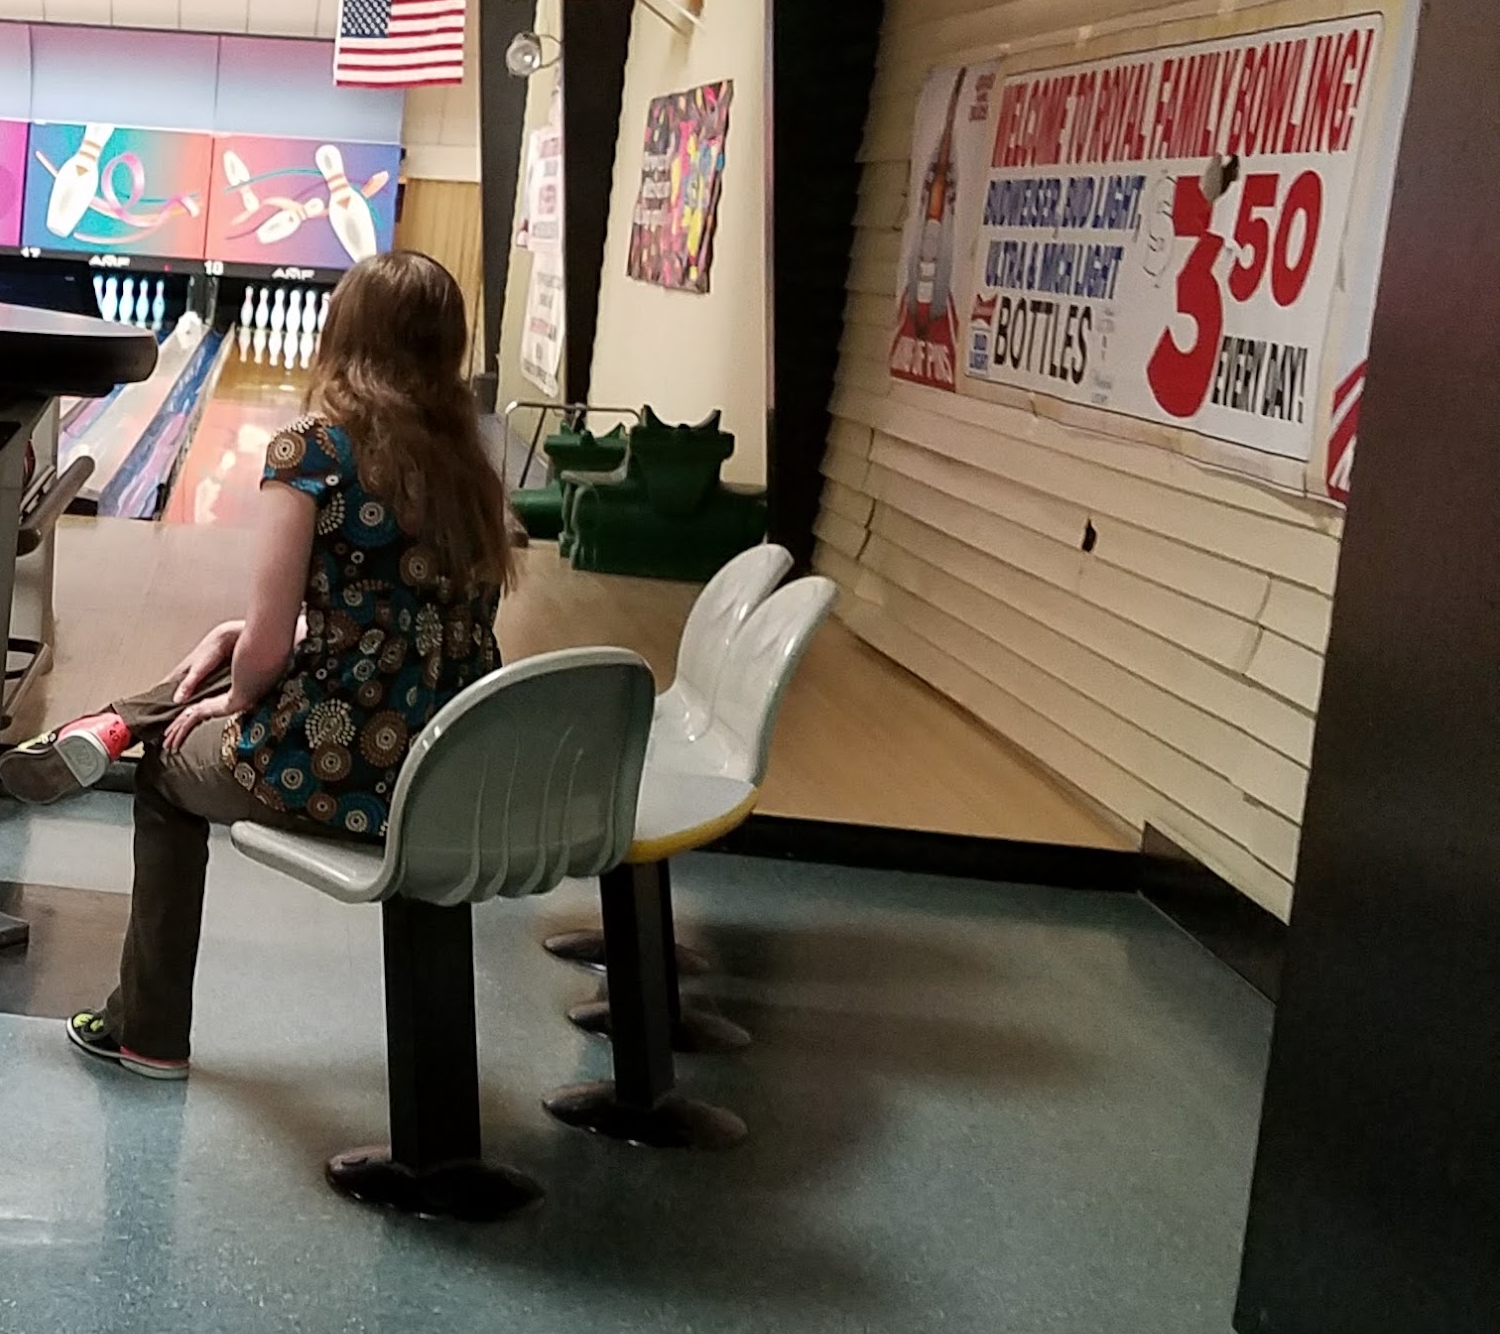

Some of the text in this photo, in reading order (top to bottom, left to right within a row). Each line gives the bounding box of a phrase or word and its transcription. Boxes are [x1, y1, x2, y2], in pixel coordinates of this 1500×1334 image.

[1067, 70, 1097, 165] TO
[1087, 62, 1154, 164] ROYAL
[1150, 49, 1240, 160] FAMILY
[1227, 28, 1374, 158] BOWLING!
[89, 254, 131, 268] AMF
[271, 267, 316, 281] AMF
[994, 295, 1093, 384] BOTTLES
[1211, 335, 1268, 414] EVERY
[1262, 342, 1308, 425] DAY!
